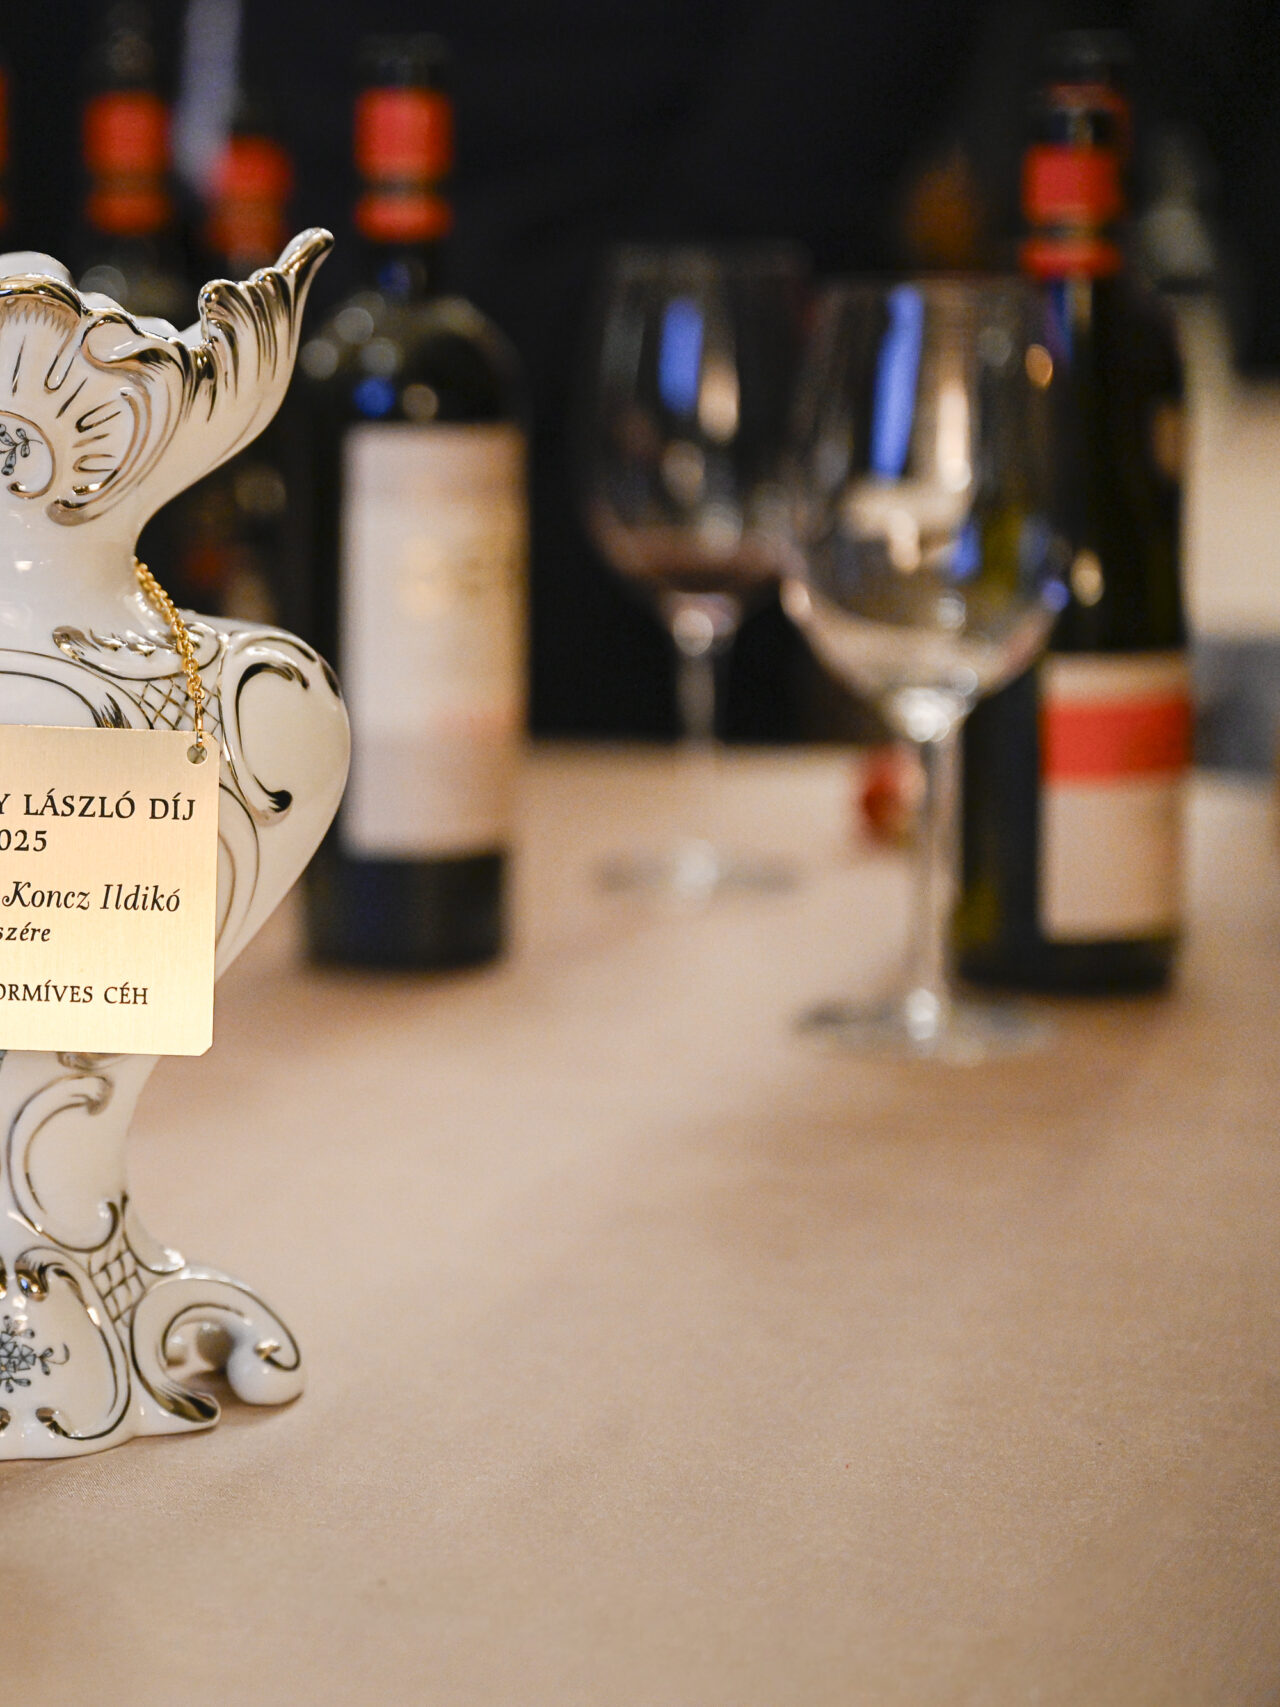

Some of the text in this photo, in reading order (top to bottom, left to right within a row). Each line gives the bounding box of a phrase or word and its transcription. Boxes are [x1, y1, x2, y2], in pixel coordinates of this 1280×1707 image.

[23, 787, 136, 819] LÁSZLÓ
[148, 791, 196, 821] DÍJ
[1, 880, 91, 911] Koncz
[99, 883, 181, 913] Ildikó
[103, 981, 149, 1006] CÉH
